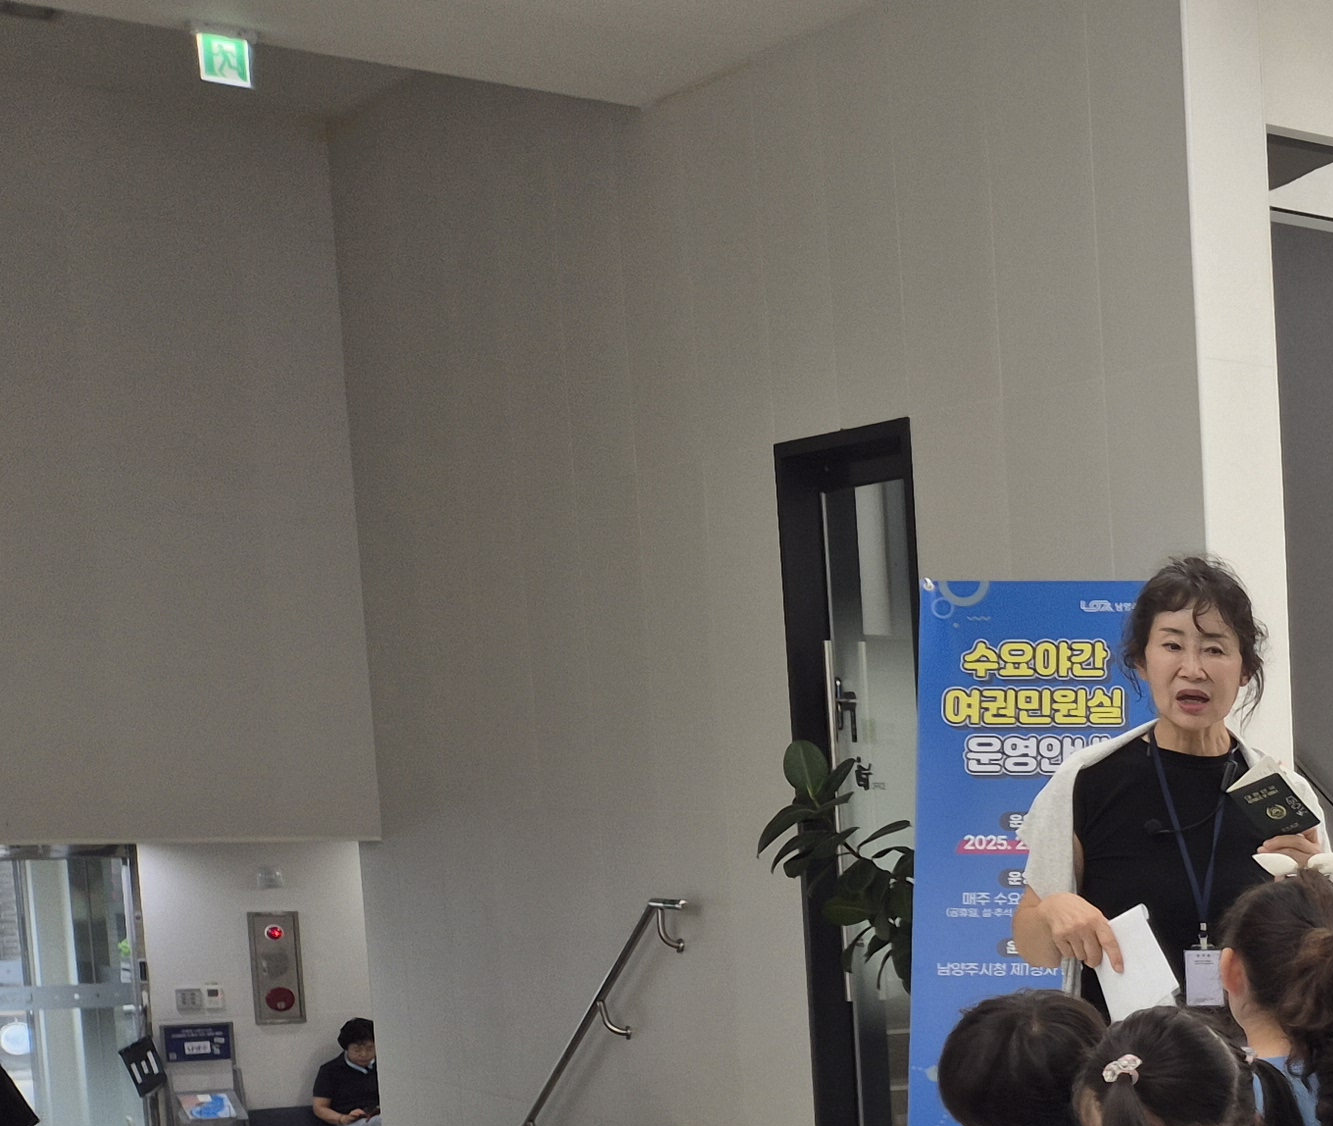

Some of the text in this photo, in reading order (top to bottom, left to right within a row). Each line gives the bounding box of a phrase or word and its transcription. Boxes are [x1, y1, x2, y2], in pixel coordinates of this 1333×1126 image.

[962, 640, 1109, 679] 수요야간
[942, 687, 1125, 727] 여권민원실
[963, 835, 1011, 850] 2025.
[963, 892, 1023, 905] 매주 수요
[937, 962, 1006, 976] 남양주시청
